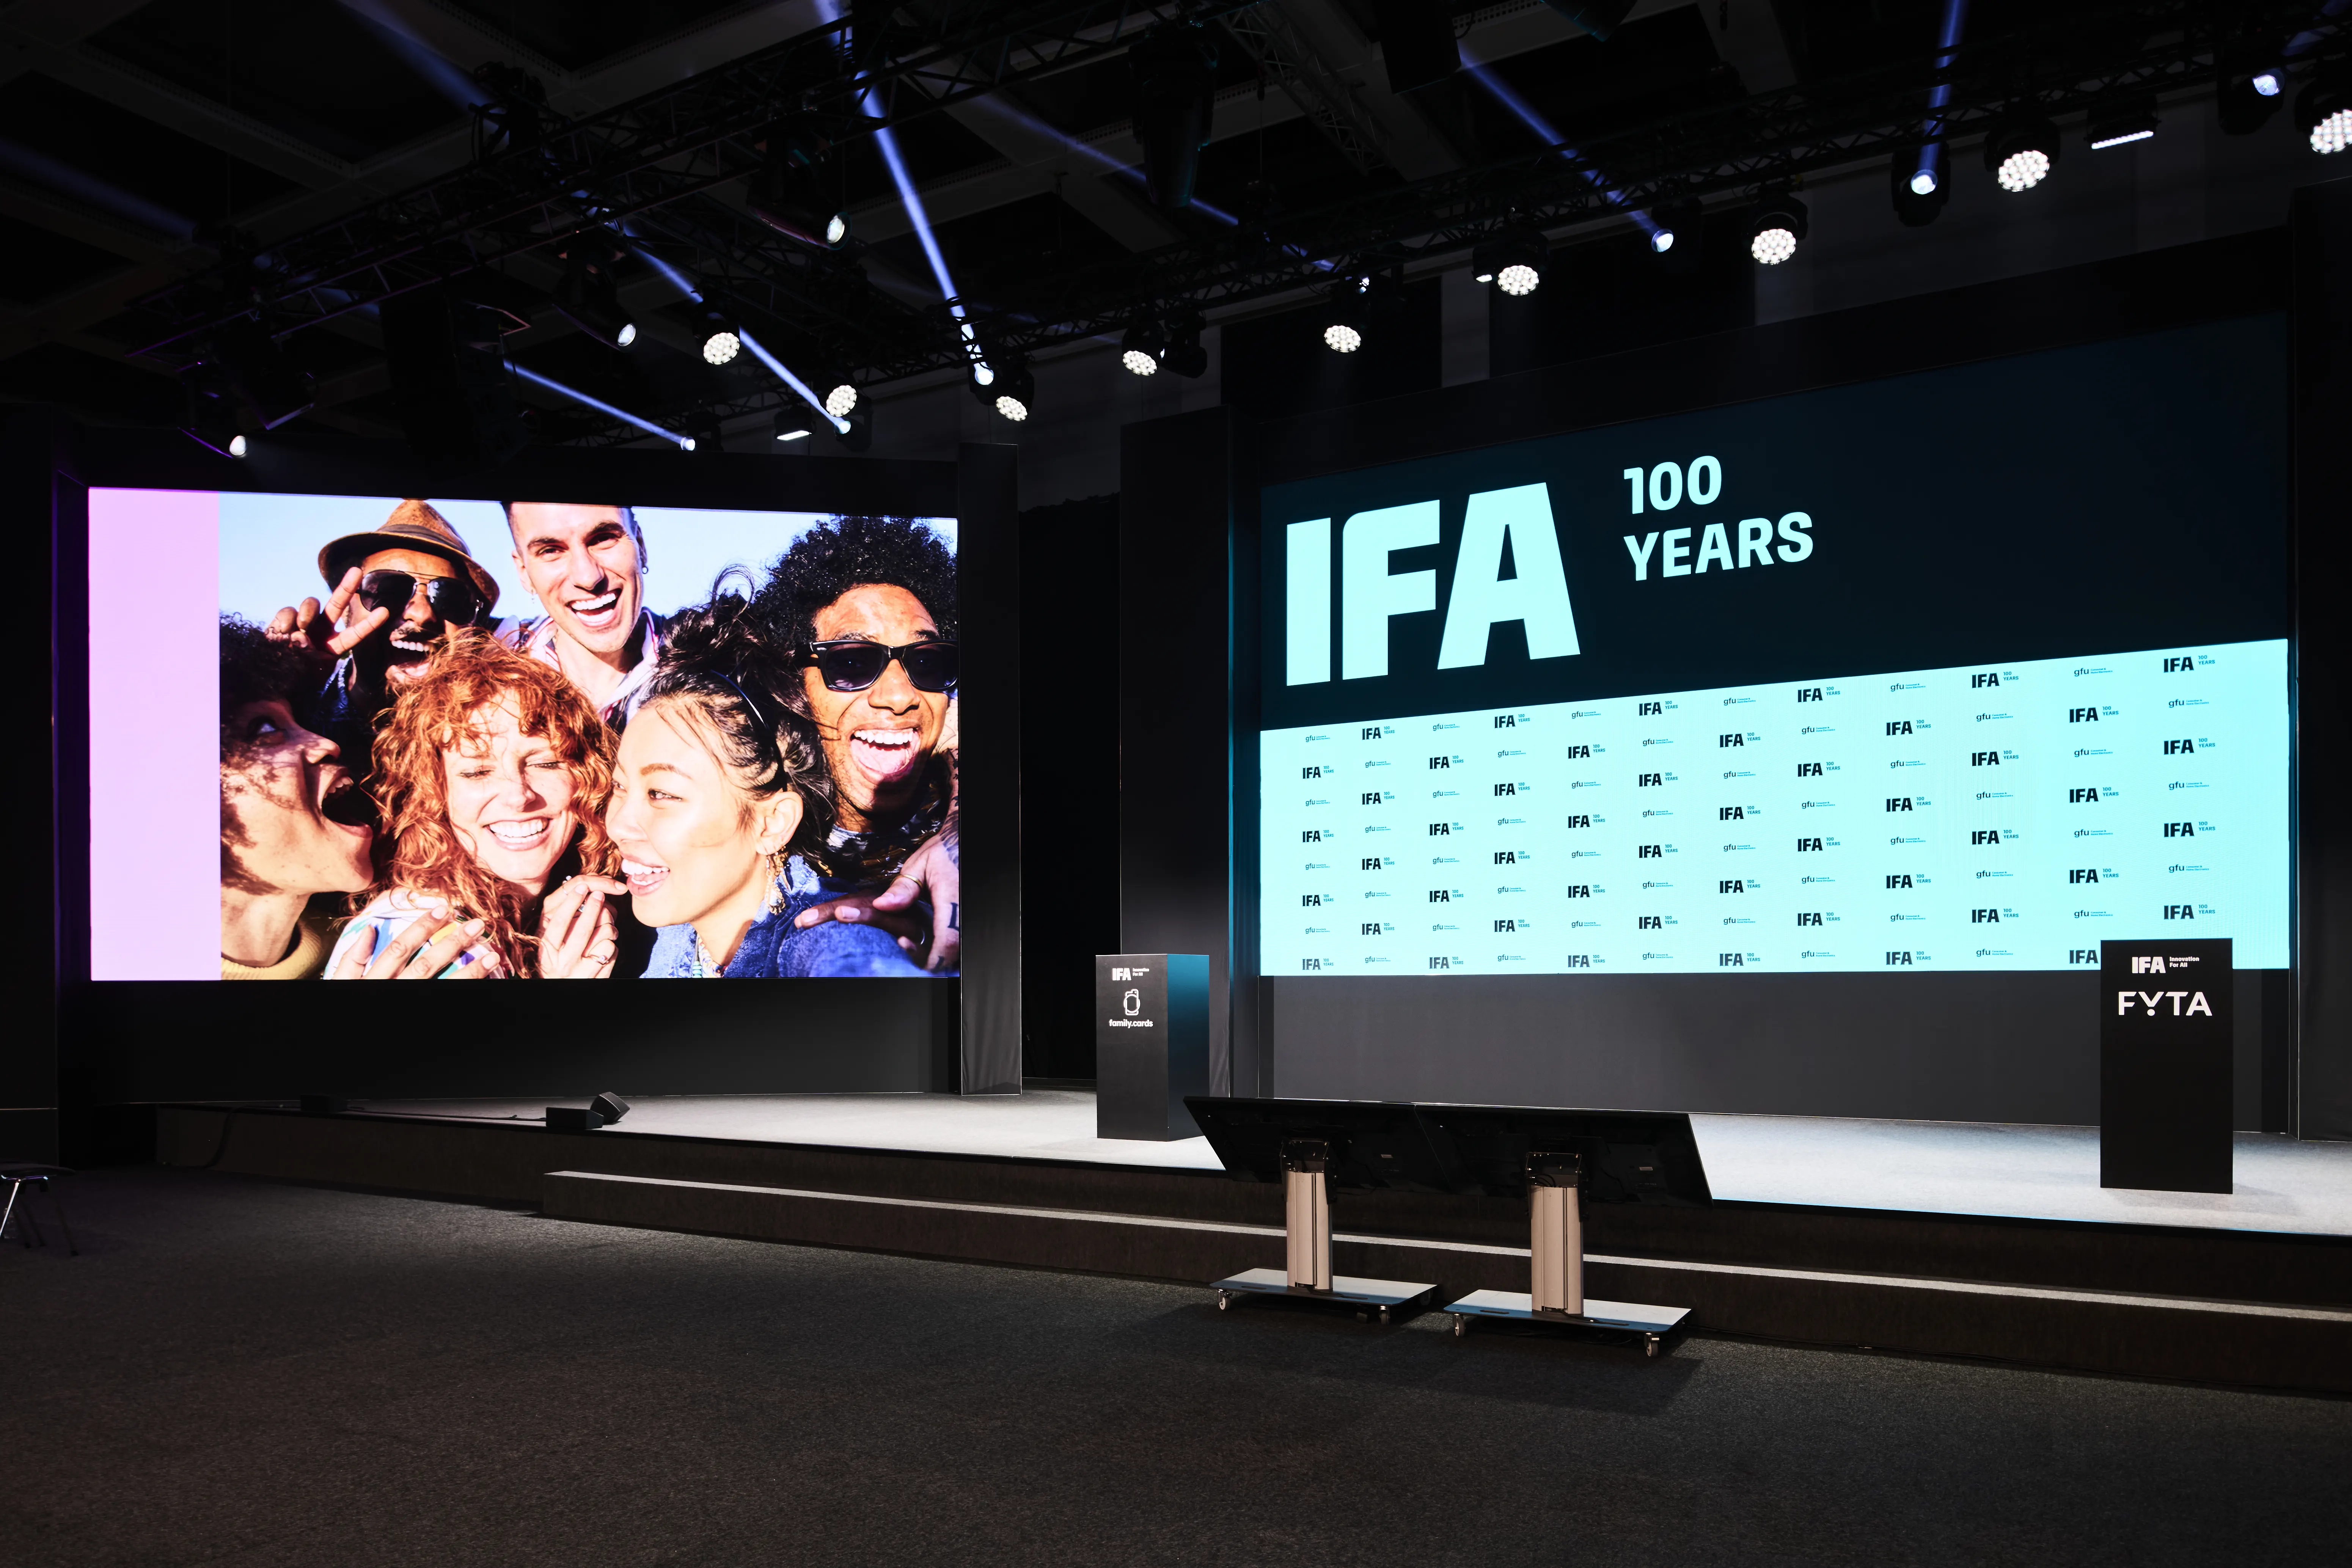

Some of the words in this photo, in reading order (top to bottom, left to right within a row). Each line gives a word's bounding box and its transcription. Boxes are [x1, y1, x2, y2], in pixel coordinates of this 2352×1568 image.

[1624, 456, 1722, 514] 100
[1624, 511, 1813, 581] YEARS
[1287, 482, 1581, 687] IFA
[2164, 657, 2194, 672] IFA
[2074, 668, 2089, 677] gfu
[1891, 683, 1904, 691] gfu
[1972, 673, 2000, 688] IFA
[1798, 688, 1823, 702] IFA
[1639, 702, 1662, 716] IFA
[2169, 699, 2184, 708] gfu
[1976, 713, 1991, 722] gfu
[2069, 707, 2099, 723] IFA
[1495, 715, 1515, 729] IFA
[1886, 721, 1913, 735] IFA
[1362, 727, 1381, 740] IFA
[1720, 734, 1744, 748] IFA
[2164, 739, 2194, 755] IFA
[1568, 745, 1590, 759] IFA
[1972, 751, 2000, 766] IFA
[1430, 756, 1450, 769] IFA
[1303, 767, 1321, 779] IFA
[1798, 763, 1823, 777] IFA
[1639, 773, 1662, 787] IFA
[1495, 783, 1515, 796] IFA
[2069, 788, 2099, 803] IFA
[1362, 792, 1381, 805] IFA
[1886, 798, 1913, 812] IFA
[1720, 807, 1744, 820] IFA
[1568, 815, 1590, 828] IFA
[1430, 823, 1450, 836] IFA
[2074, 829, 2089, 837] gfu
[2164, 822, 2194, 837] IFA
[1302, 831, 1321, 842] IFA
[1972, 830, 2000, 845] IFA
[1639, 845, 1662, 858] IFA
[1798, 838, 1823, 852] IFA
[1362, 858, 1381, 870] IFA
[1495, 852, 1516, 864] IFA
[2169, 864, 2184, 873] gfu
[1886, 875, 1913, 889] IFA
[2069, 869, 2099, 883] IFA
[1568, 885, 1590, 898] IFA
[1720, 880, 1744, 893] IFA
[1302, 895, 1321, 906] IFA
[1430, 890, 1450, 902] IFA
[1972, 909, 1999, 923] IFA
[2164, 905, 2194, 919] IFA
[1494, 920, 1515, 932] IFA
[1639, 916, 1662, 929] IFA
[1798, 913, 1823, 926] IFA
[1362, 923, 1381, 935] IFA
[1430, 957, 1450, 969] IFA
[1568, 955, 1590, 967] IFA
[1720, 954, 1744, 966] IFA
[1886, 952, 1912, 965] IFA
[2069, 950, 2099, 963] IFA
[1302, 959, 1321, 970] IFA
[2132, 957, 2166, 973] IFA
[1112, 968, 1132, 981] IFA
[2118, 991, 2212, 1016] FYTA
[1109, 1019, 1153, 1029] family.cards
